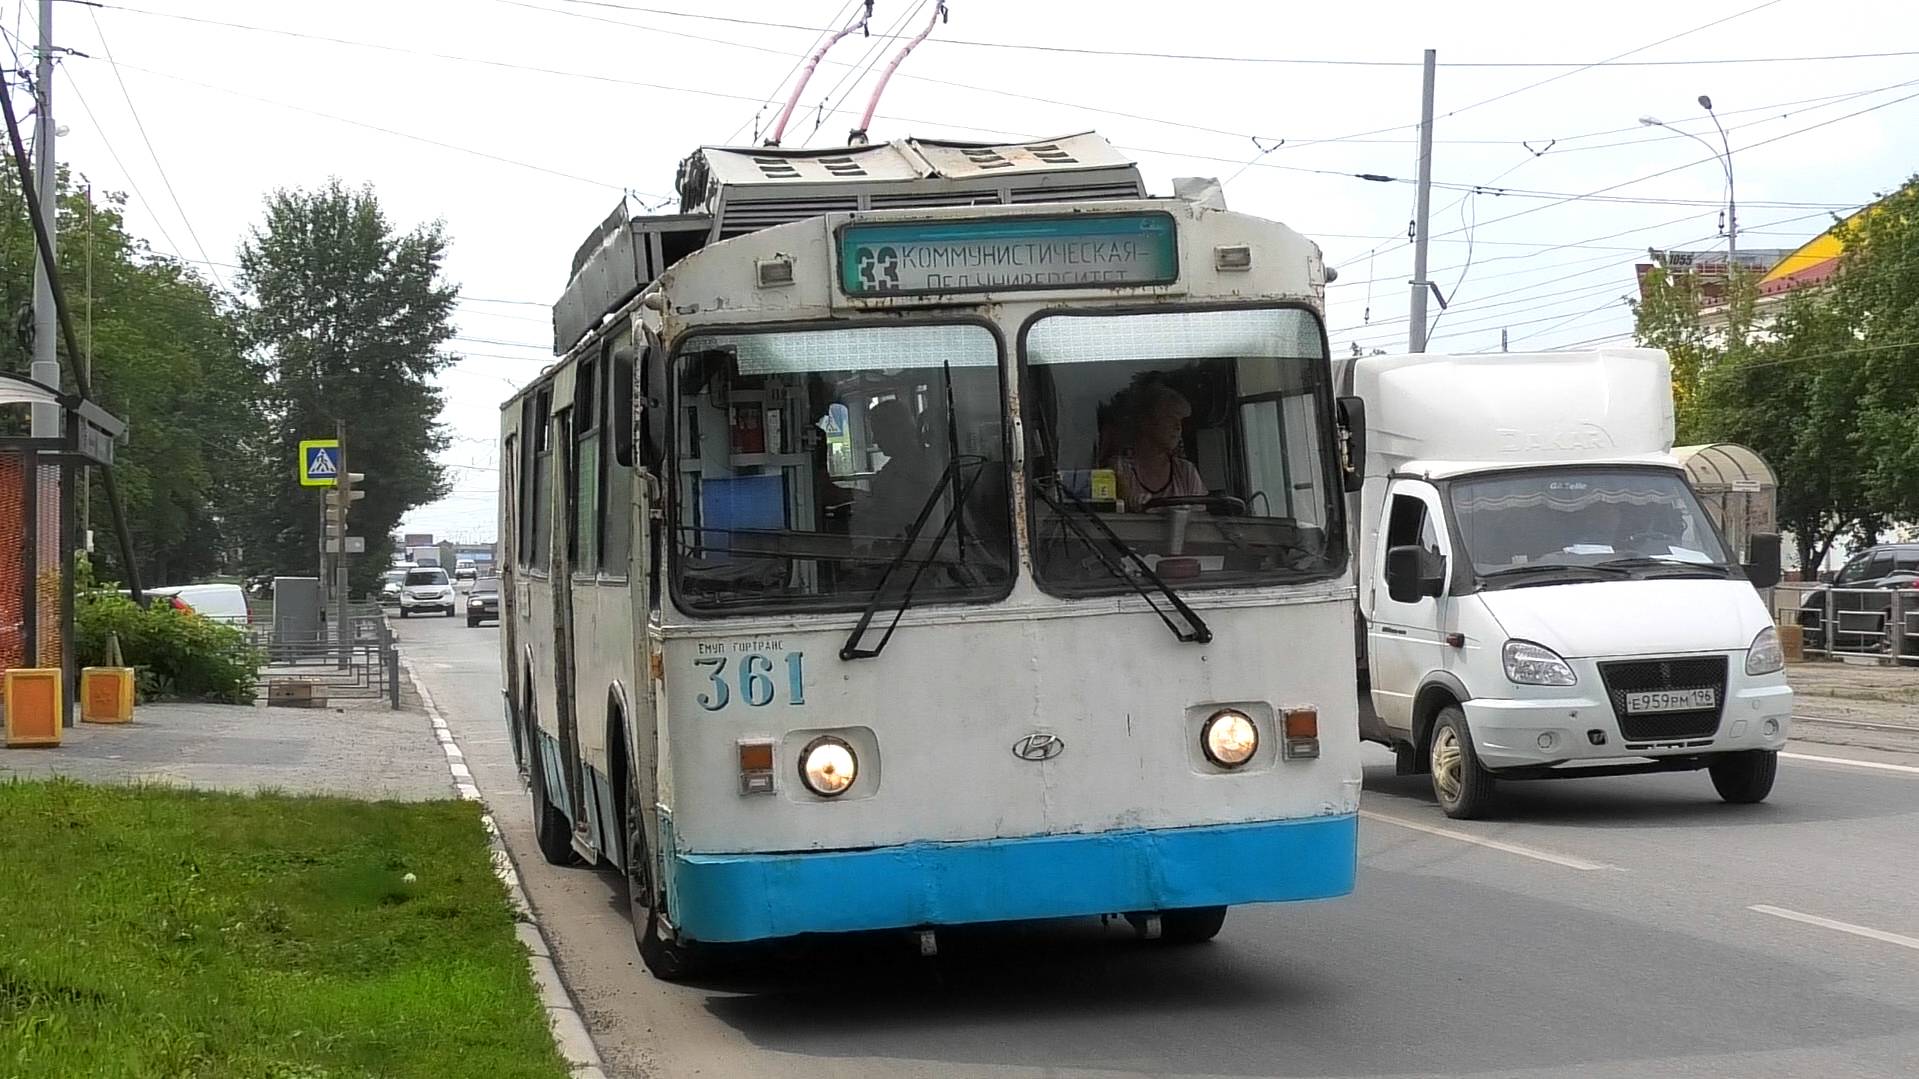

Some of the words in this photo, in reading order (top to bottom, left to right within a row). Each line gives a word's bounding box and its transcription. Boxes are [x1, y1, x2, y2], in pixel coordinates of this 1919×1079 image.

[1669, 254, 1693, 265] 1055
[698, 643, 725, 654] ЕМУП
[694, 652, 805, 711] 361
